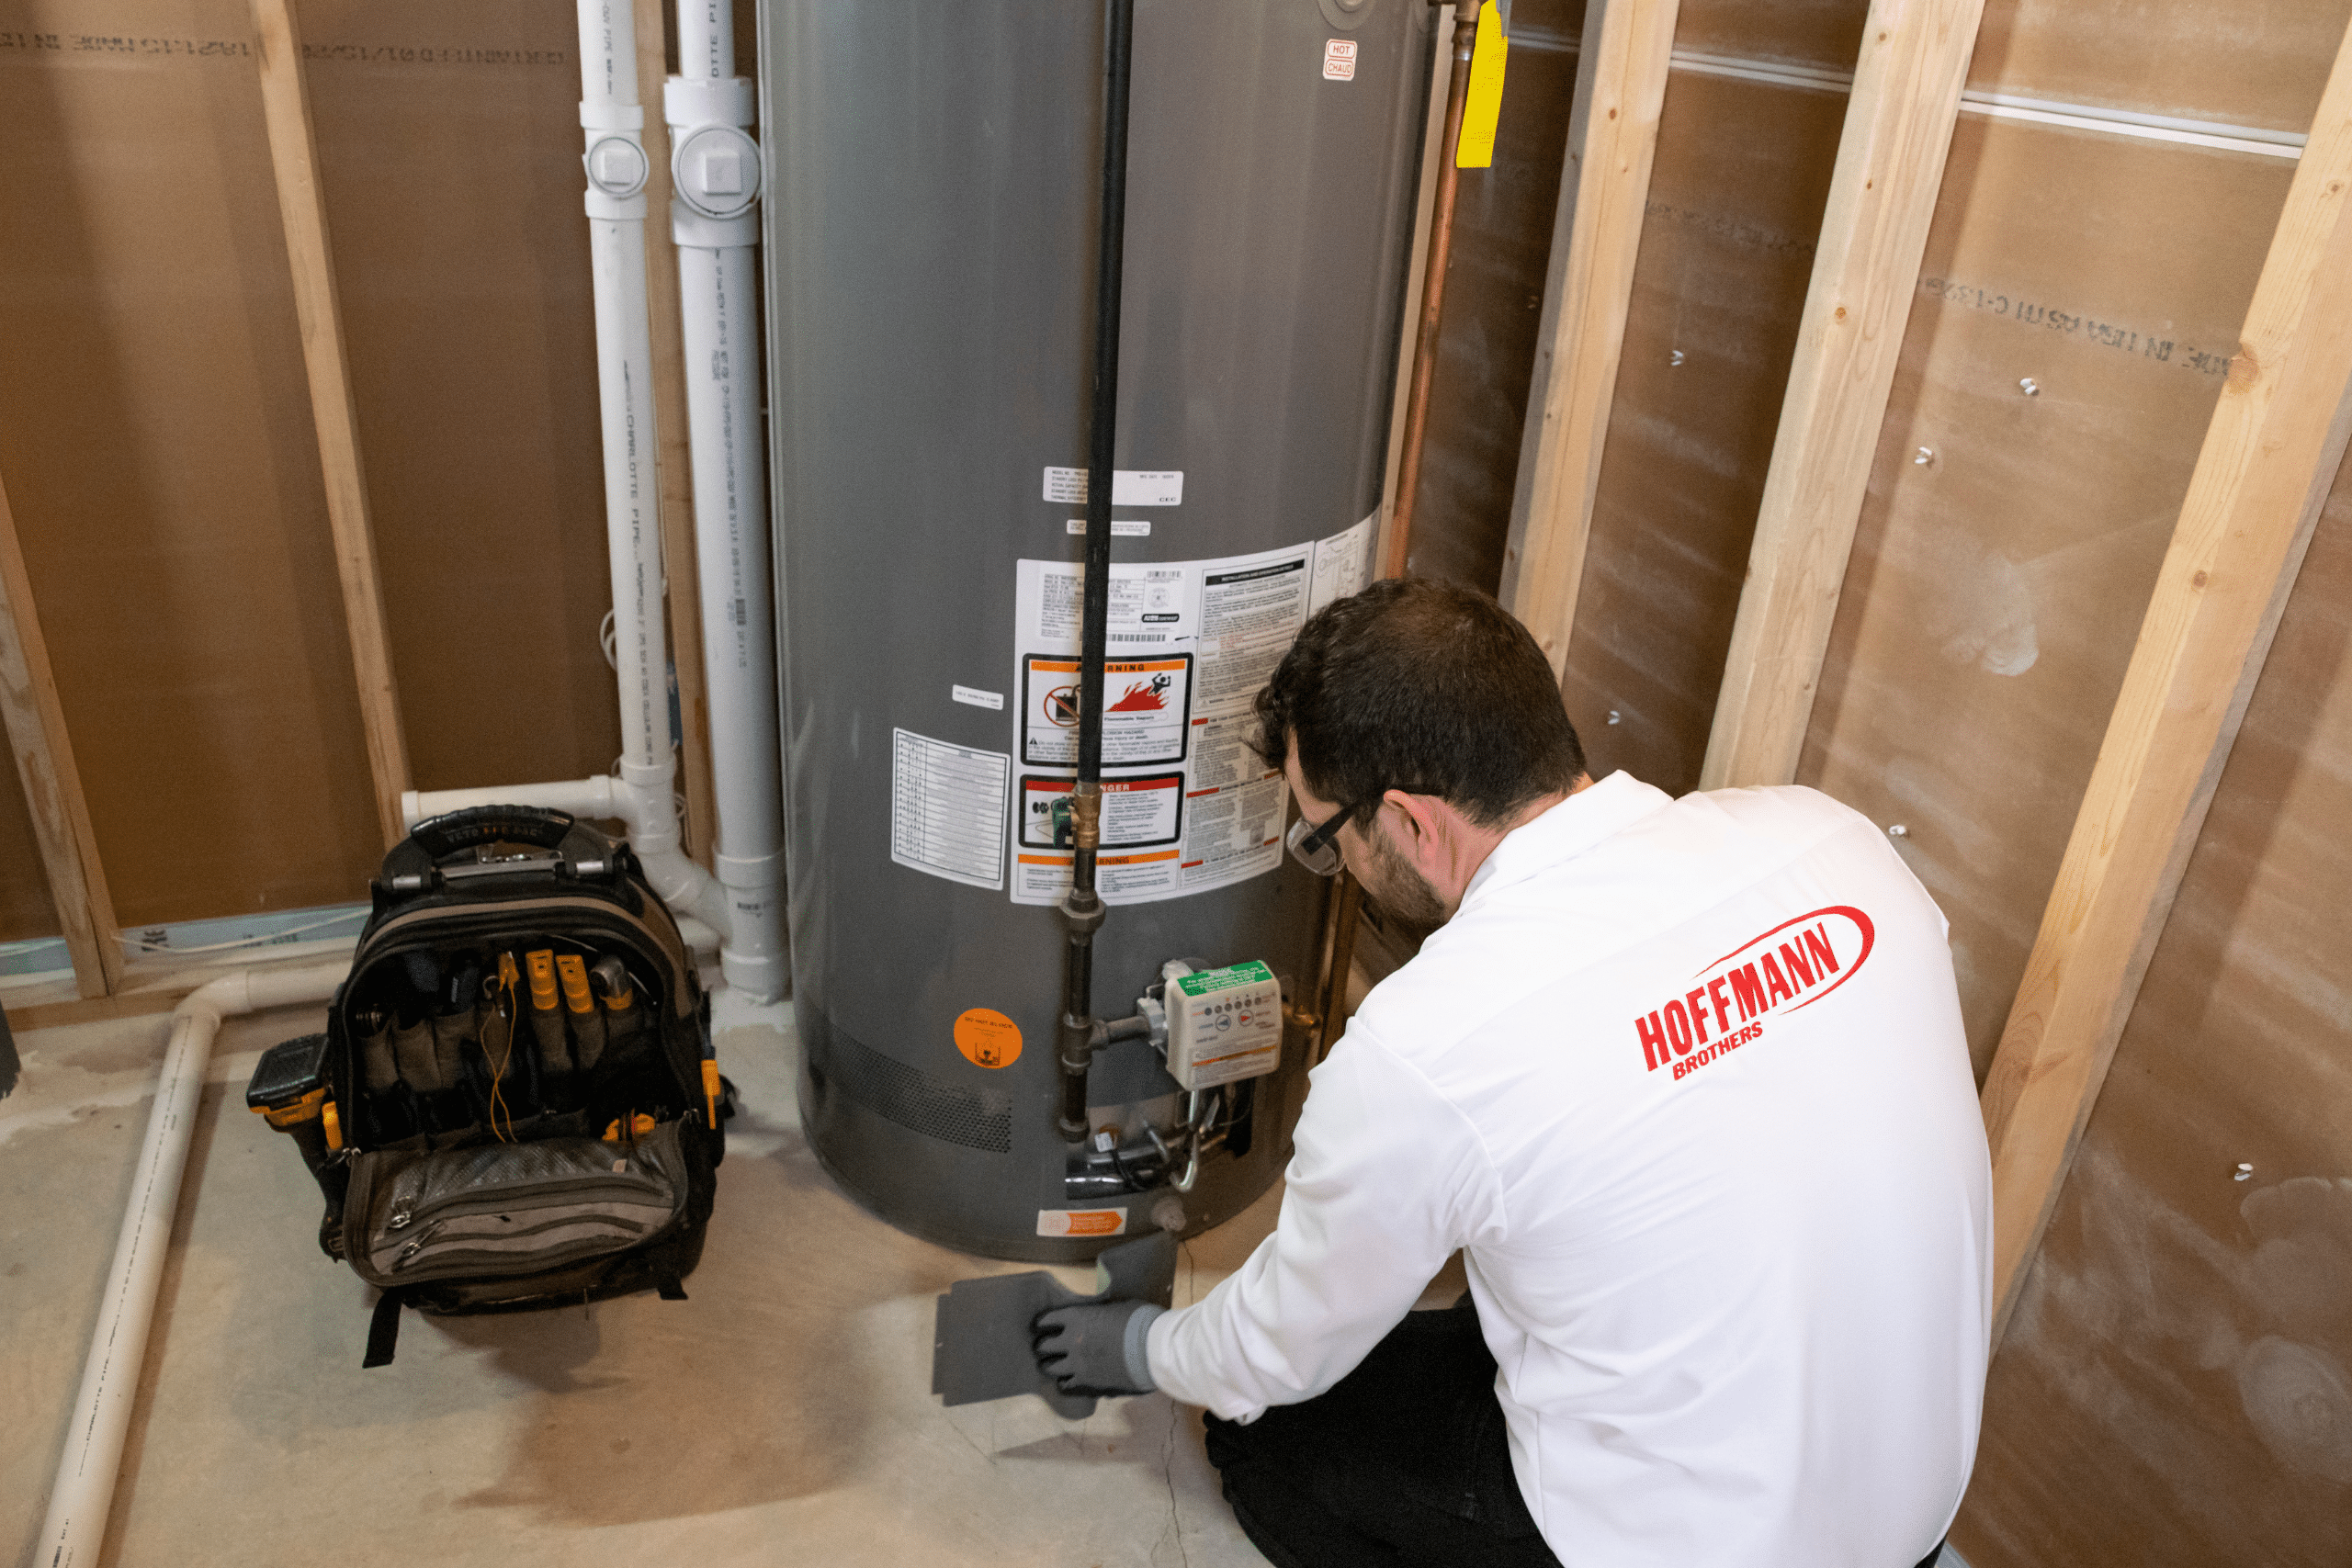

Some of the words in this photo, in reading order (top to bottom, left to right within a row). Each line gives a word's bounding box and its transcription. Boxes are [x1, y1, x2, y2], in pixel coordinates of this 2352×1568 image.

[1329, 62, 1352, 73] CHAUD
[1333, 45, 1351, 55] HOT
[627, 414, 638, 499] CHARLOTTE
[1101, 784, 1130, 792] NGER
[1634, 921, 1840, 1072] HOFFMANN
[1671, 1021, 1764, 1082] BROTHERS
